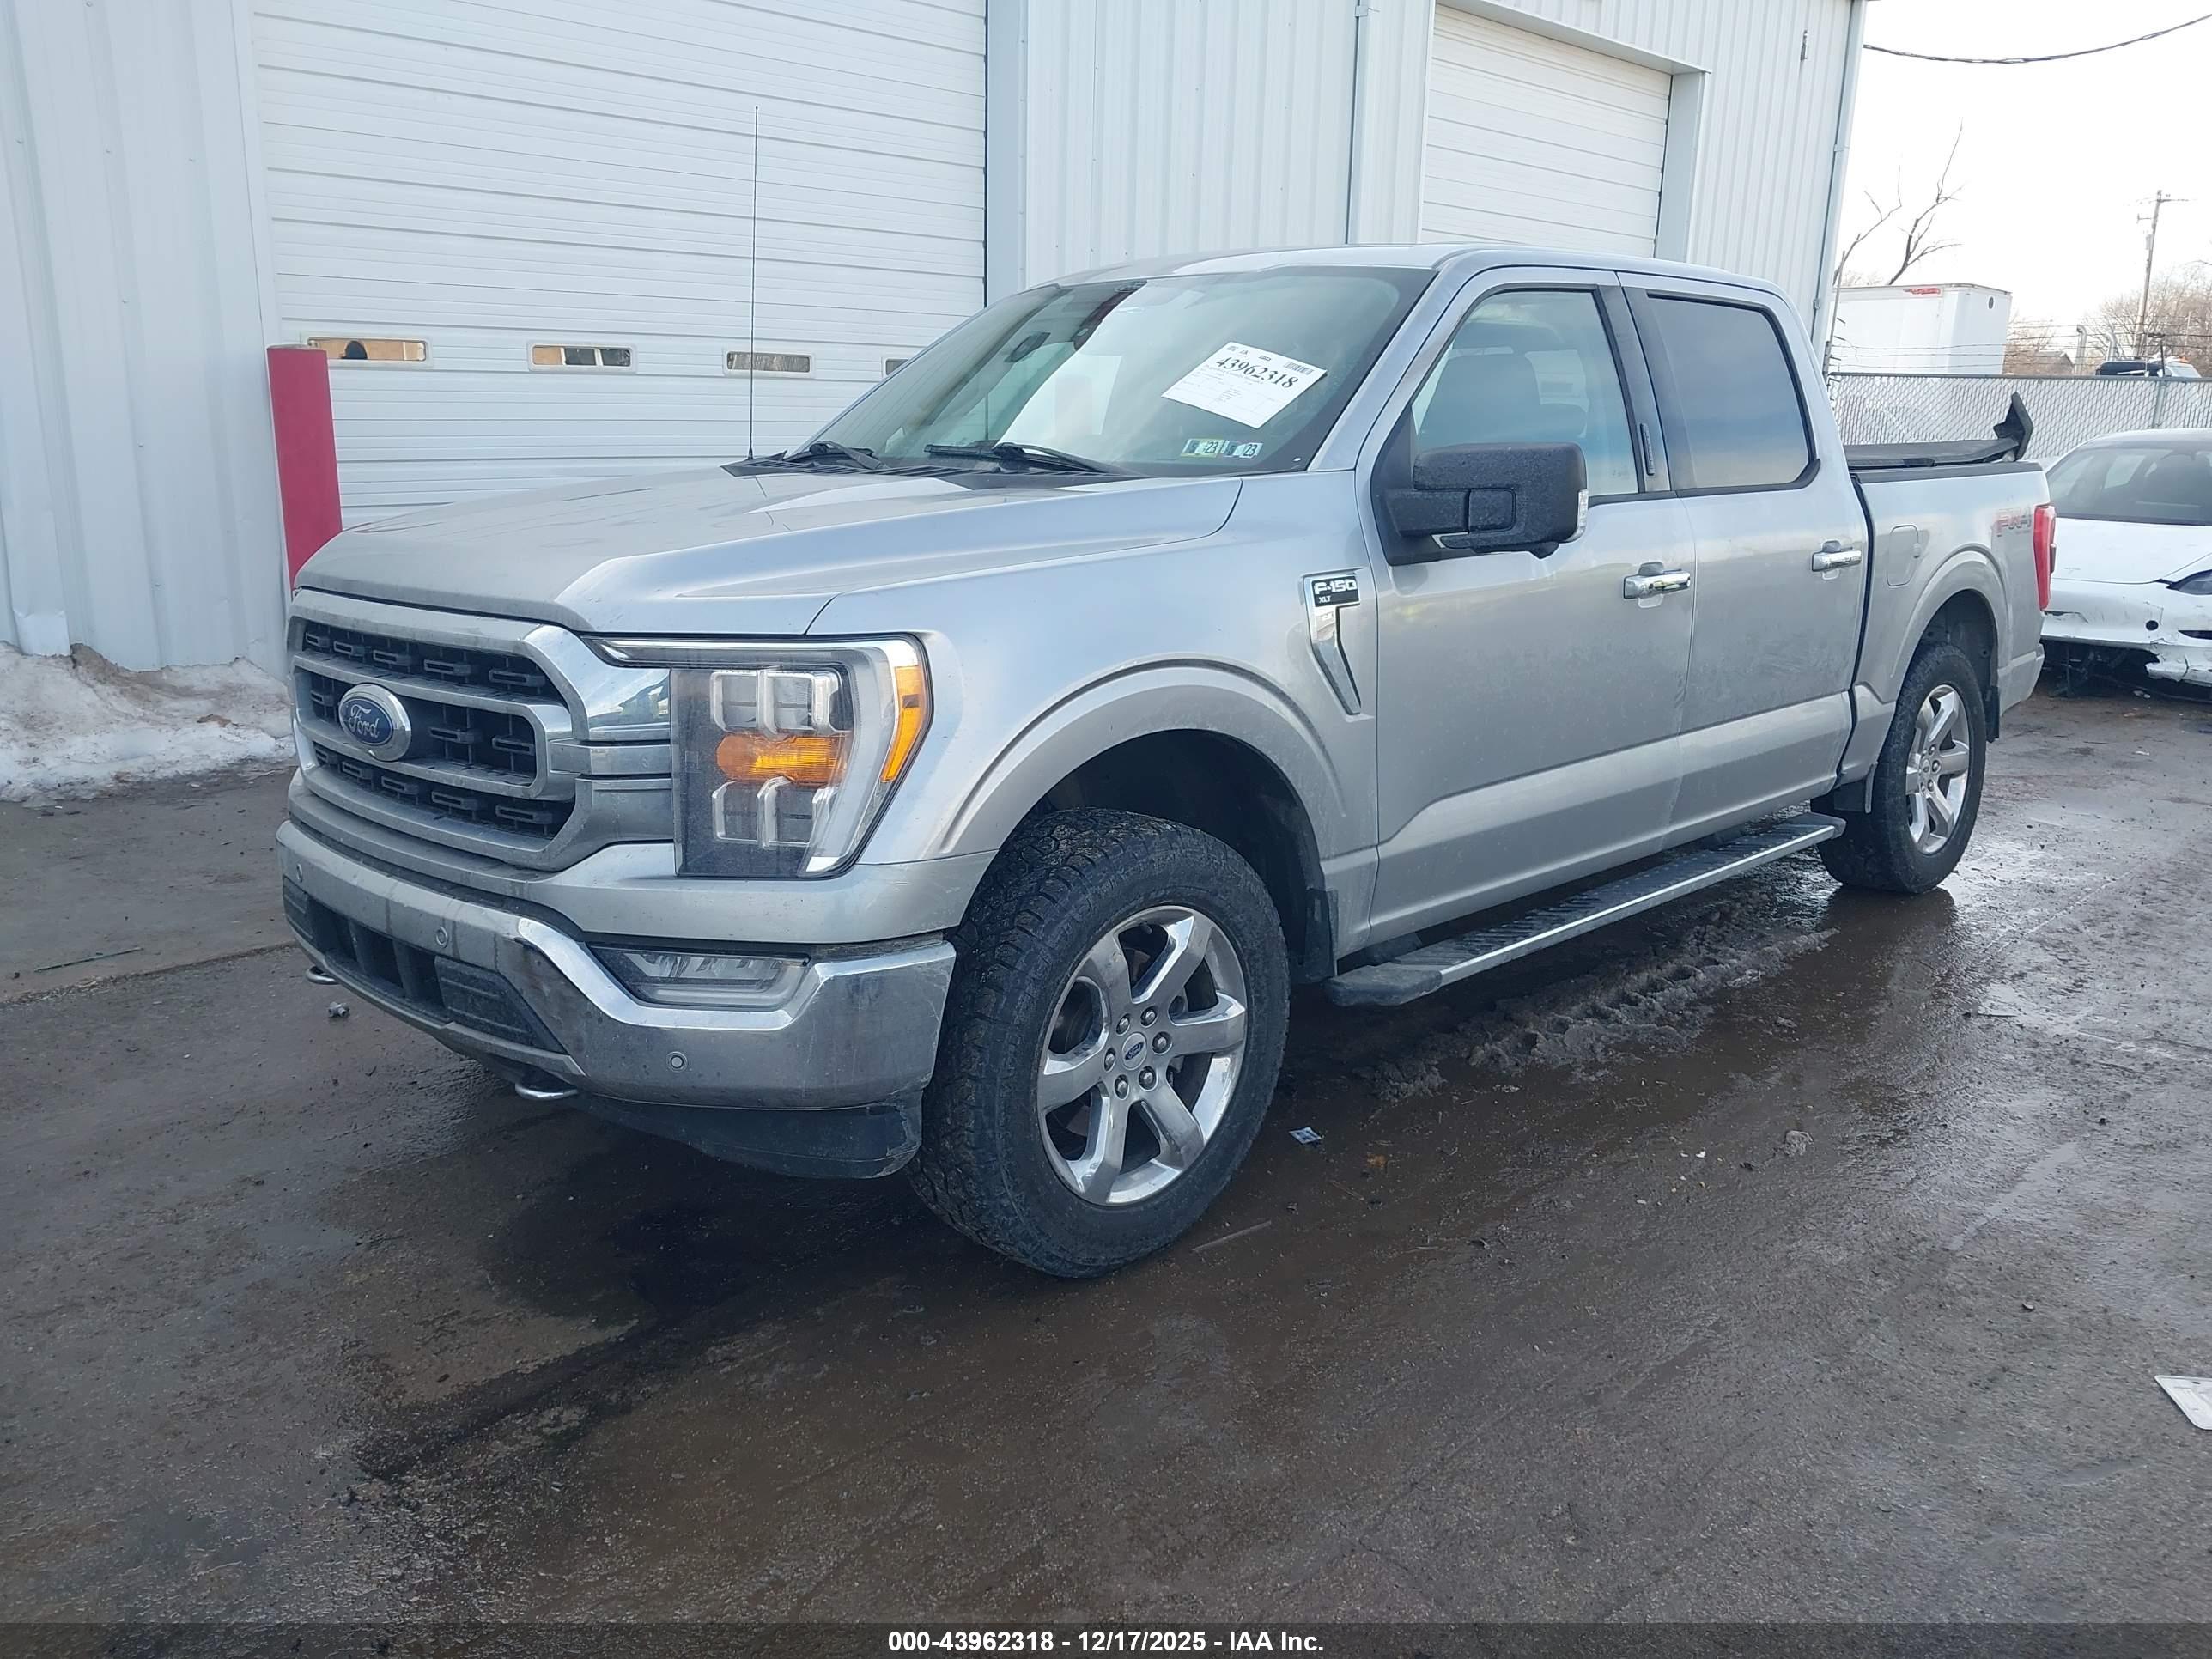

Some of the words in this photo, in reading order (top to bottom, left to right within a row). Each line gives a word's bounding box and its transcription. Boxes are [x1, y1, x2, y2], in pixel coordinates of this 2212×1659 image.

[1216, 356, 1299, 389] 43962318
[1243, 443, 1258, 457] 23
[1315, 580, 1357, 594] F-150
[349, 704, 380, 738] Ford
